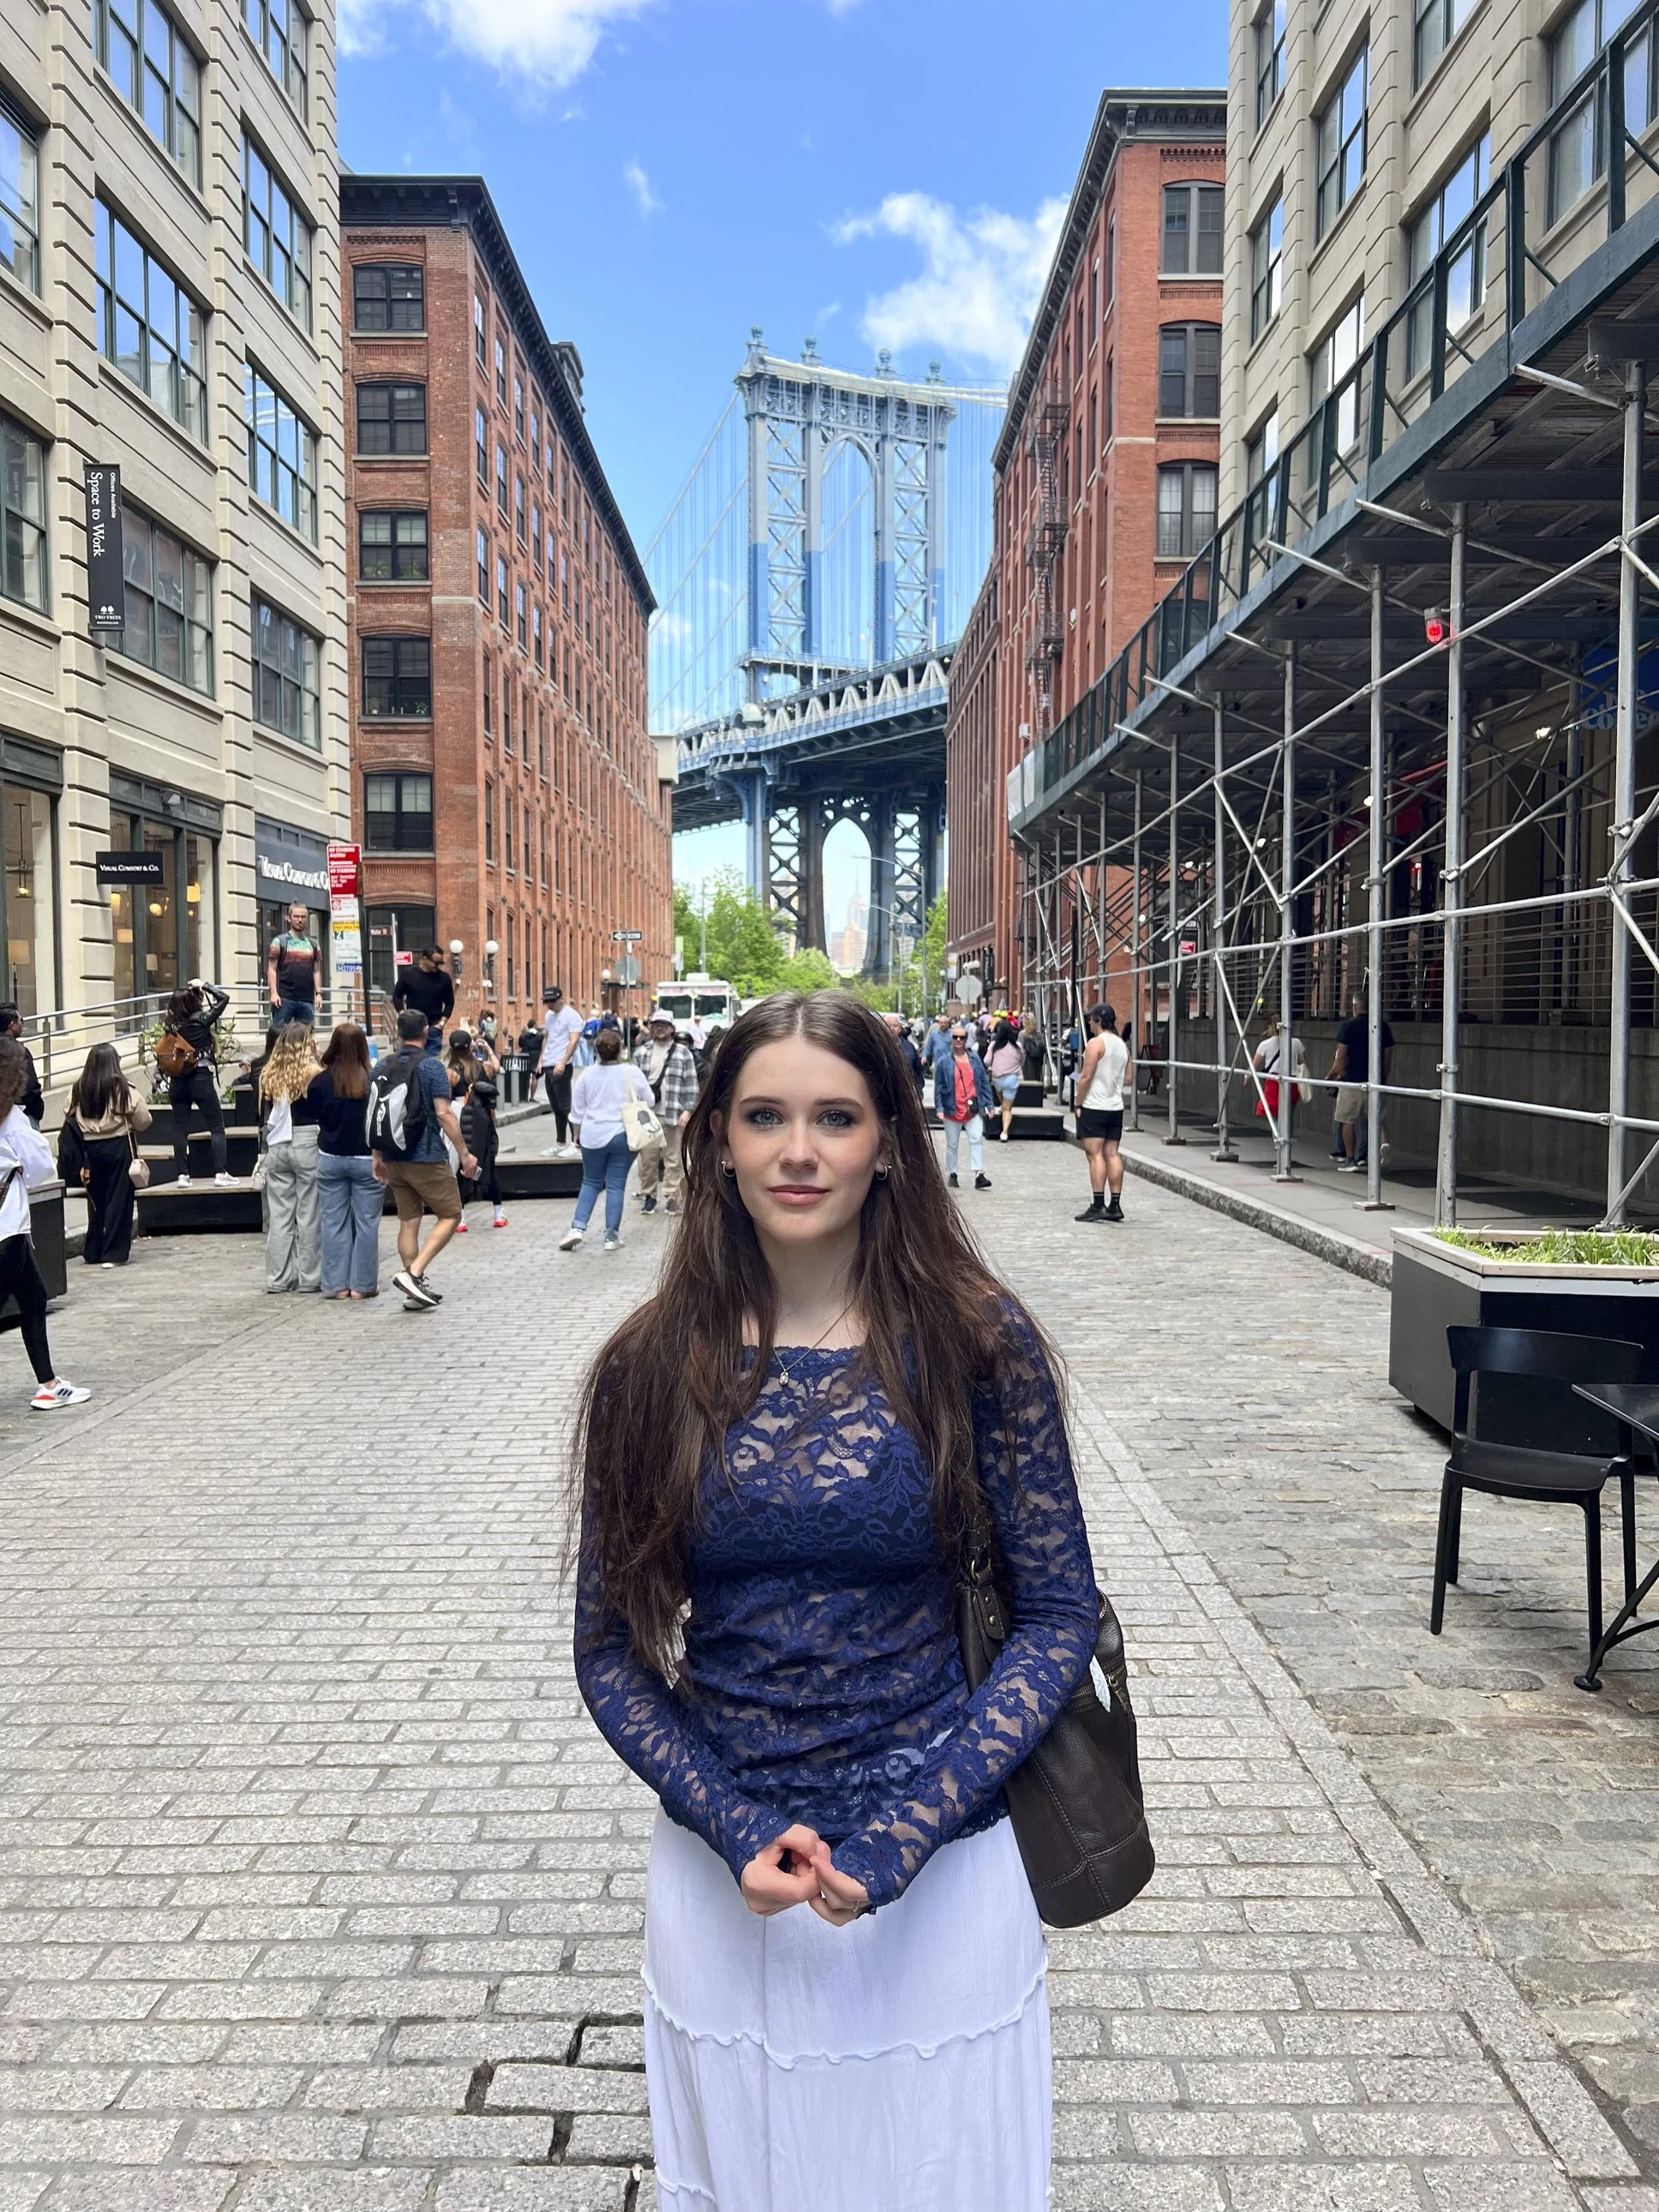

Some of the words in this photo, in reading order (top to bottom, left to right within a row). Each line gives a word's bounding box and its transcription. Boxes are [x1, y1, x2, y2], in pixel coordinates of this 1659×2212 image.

[87, 471, 103, 505] Space
[92, 508, 101, 520] to
[92, 523, 105, 557] Work
